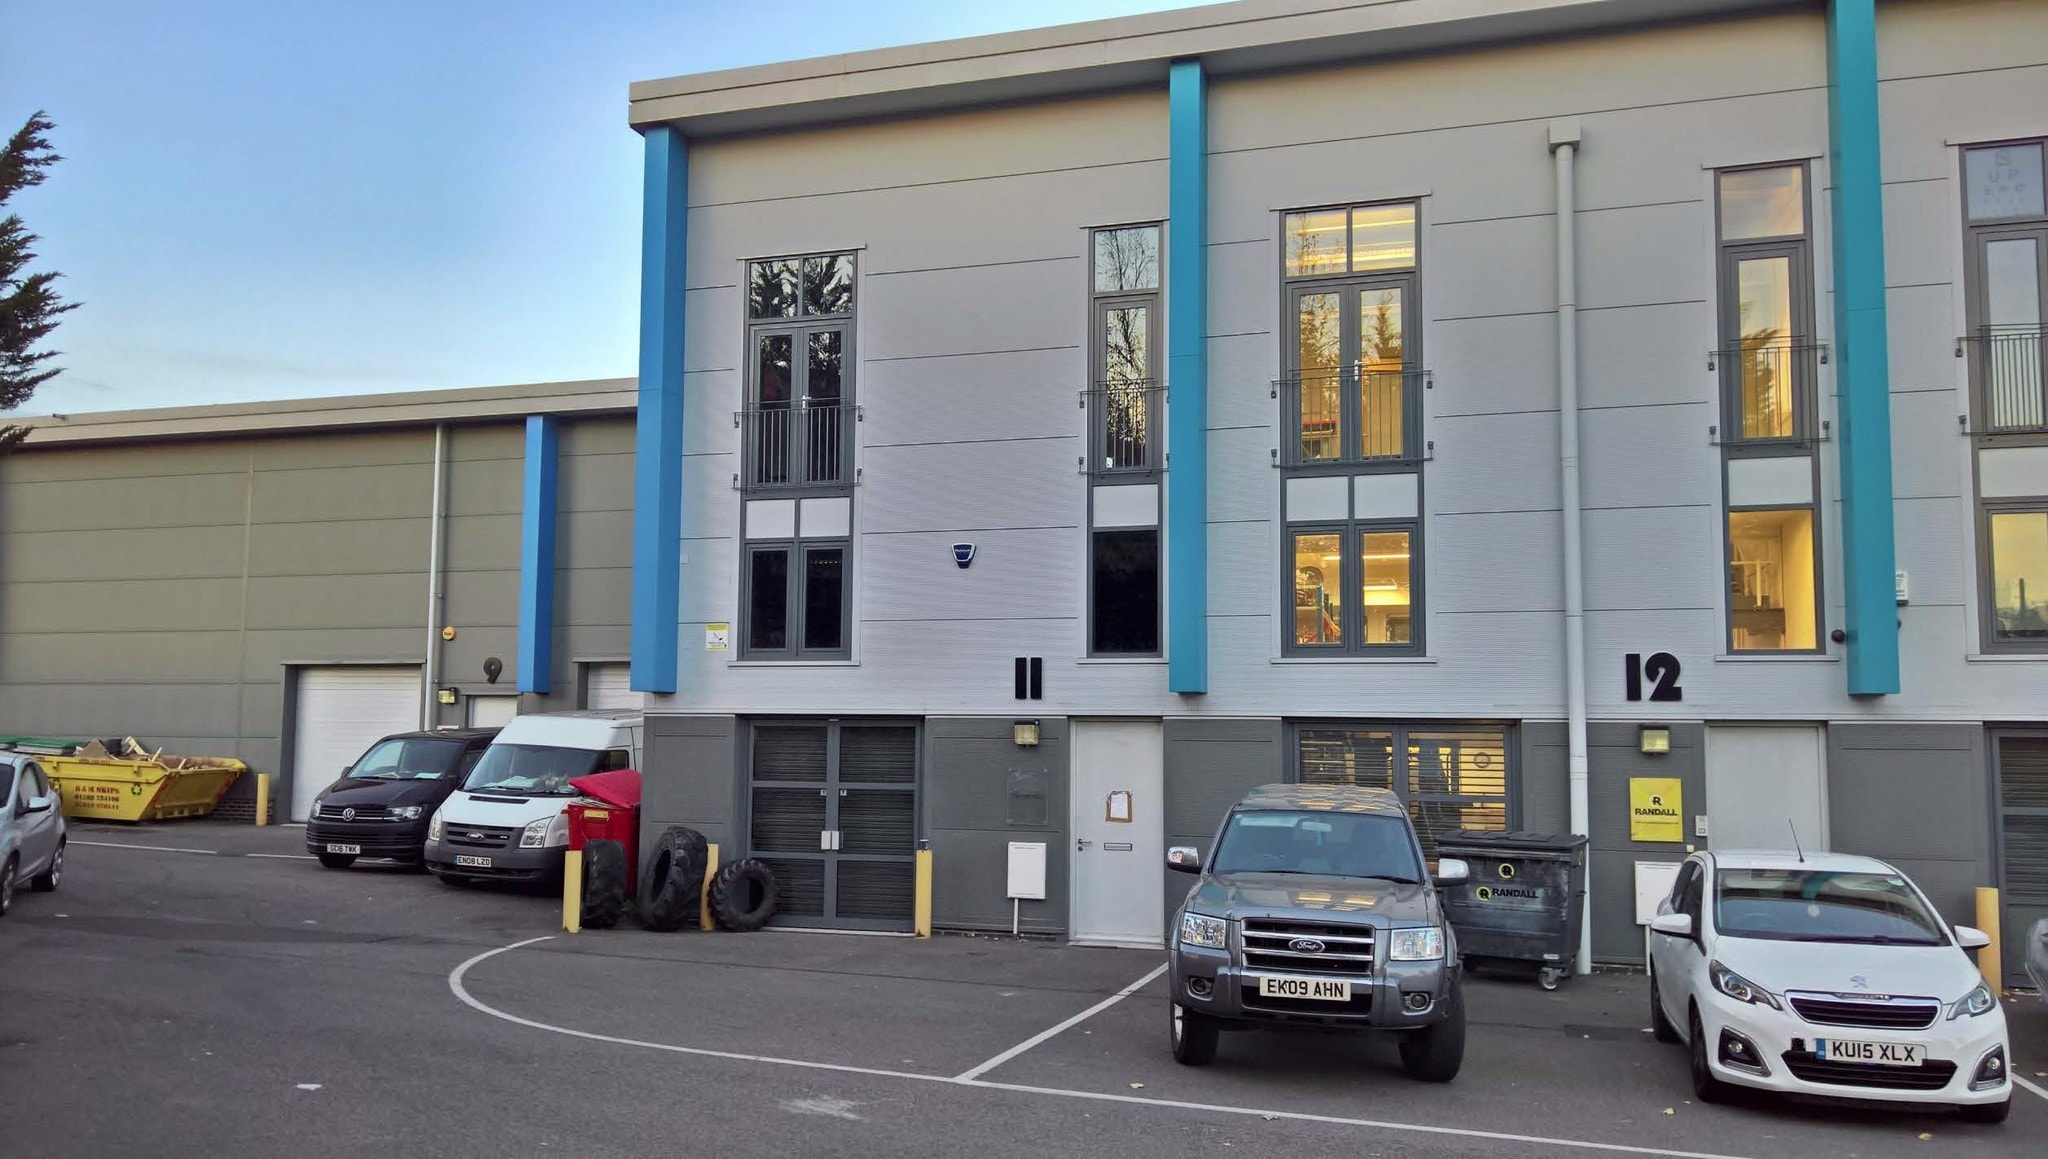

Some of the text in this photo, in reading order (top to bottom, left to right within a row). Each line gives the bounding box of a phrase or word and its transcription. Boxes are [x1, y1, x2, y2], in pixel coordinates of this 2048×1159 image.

[484, 657, 503, 684] 9
[1015, 657, 1042, 700] 11
[1625, 652, 1682, 701] 12
[1652, 796, 1662, 806] R
[1634, 808, 1679, 816] RANDALL
[1492, 888, 1540, 899] RANDALL
[1297, 941, 1319, 950] Ford
[1267, 979, 1344, 998] EK09 AHN
[1832, 1041, 1915, 1062] KU15 XLX
